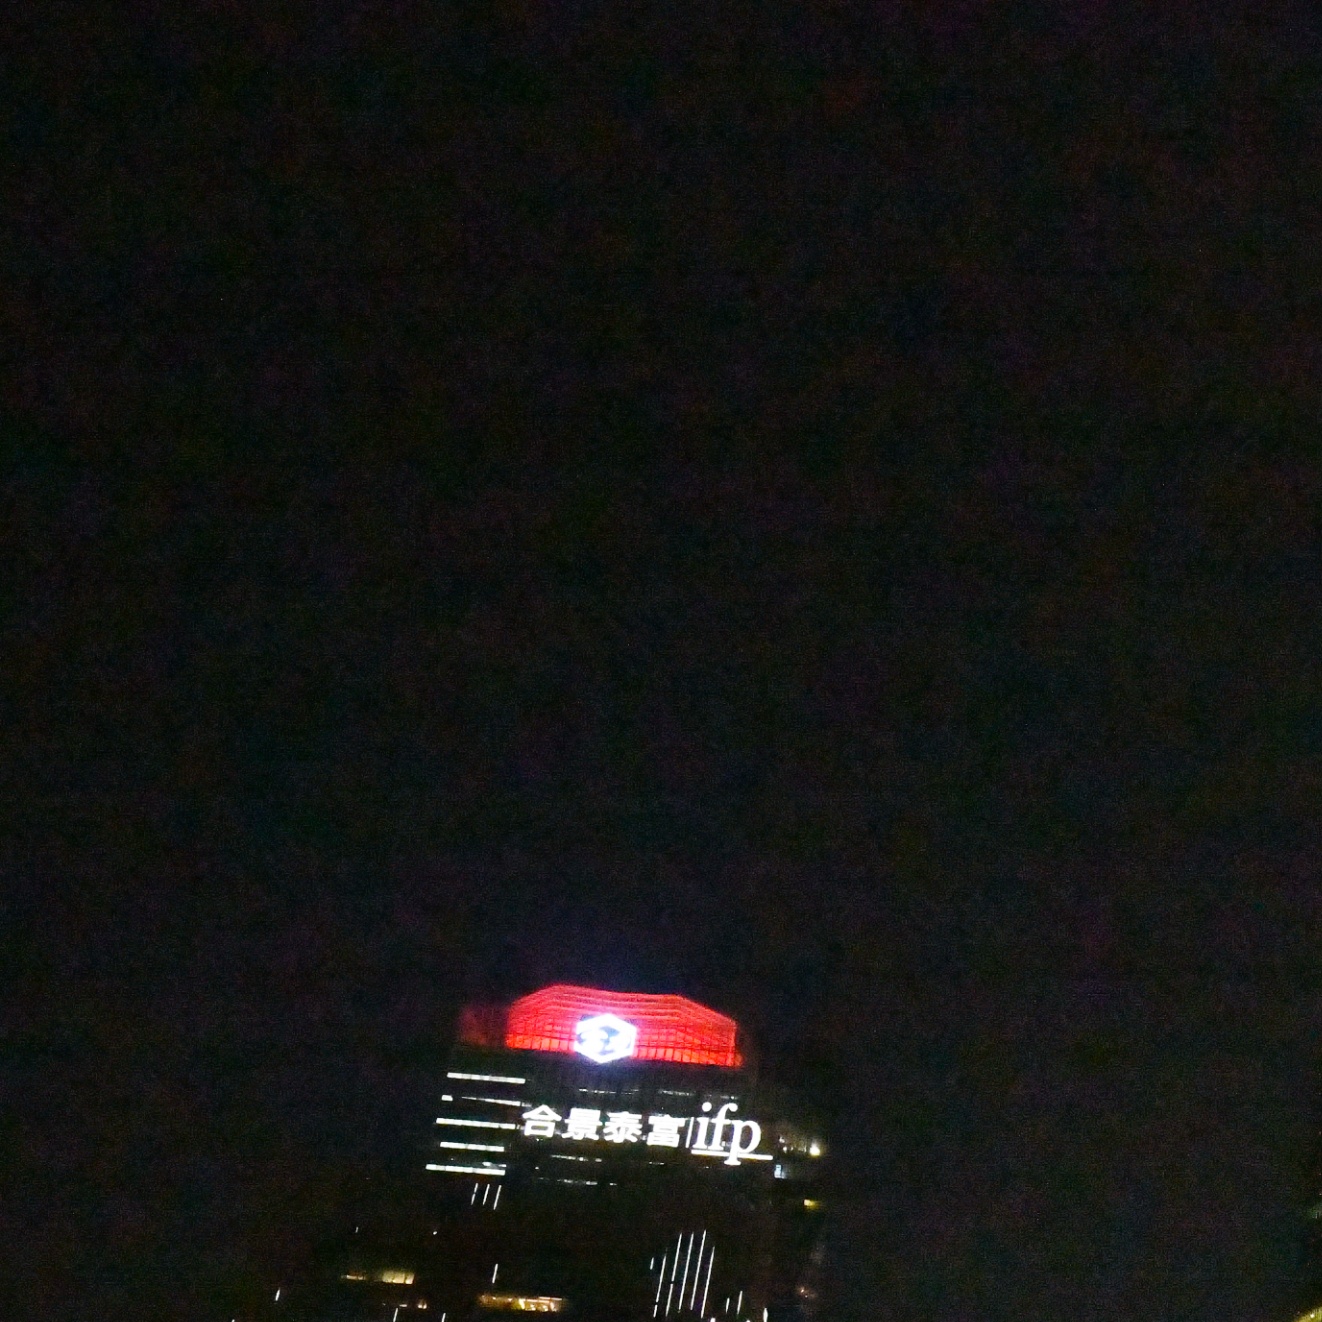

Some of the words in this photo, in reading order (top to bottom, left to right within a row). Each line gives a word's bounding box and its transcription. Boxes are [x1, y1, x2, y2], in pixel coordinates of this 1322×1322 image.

[521, 1103, 686, 1149] 合景泰富
[692, 1102, 763, 1166] ifp
